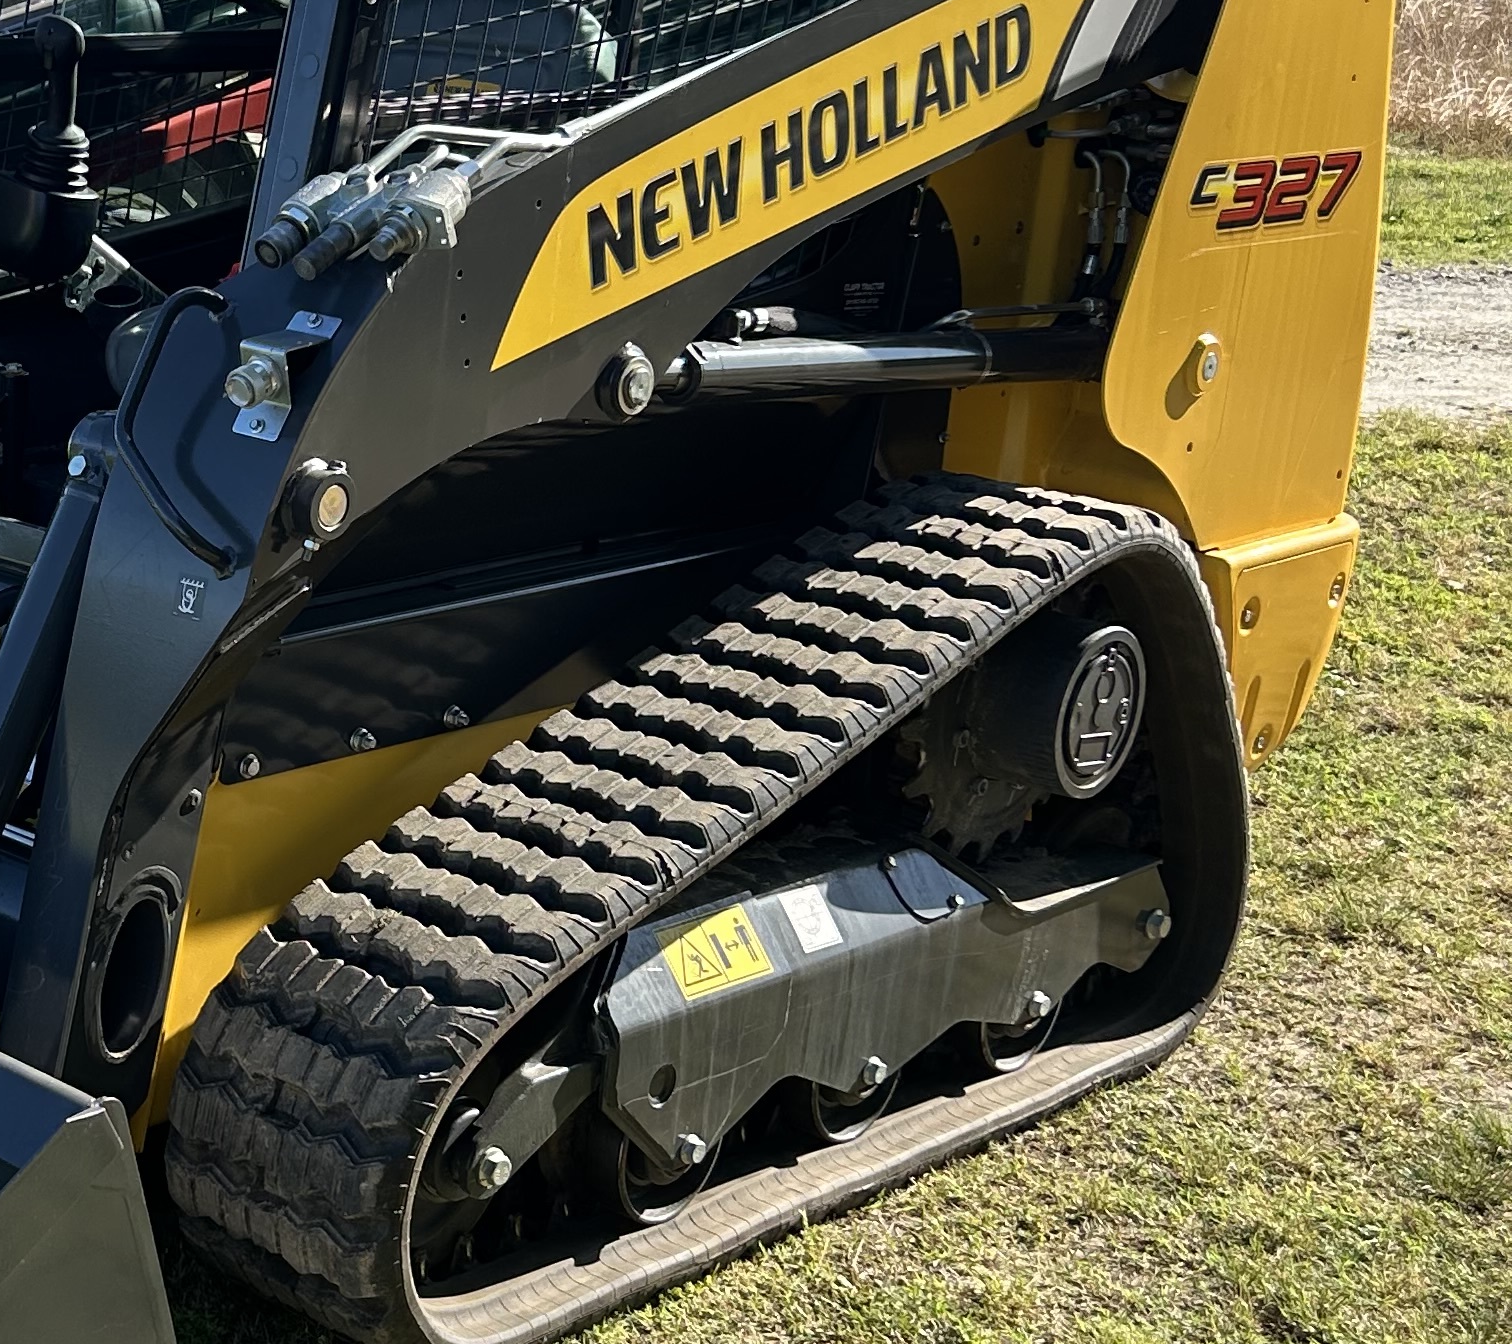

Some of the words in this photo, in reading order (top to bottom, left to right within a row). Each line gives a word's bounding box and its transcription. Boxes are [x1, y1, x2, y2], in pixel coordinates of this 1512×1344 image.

[586, 136, 743, 290] NEW
[760, 3, 1032, 205] HOLLAND
[1189, 150, 1362, 230] C327
